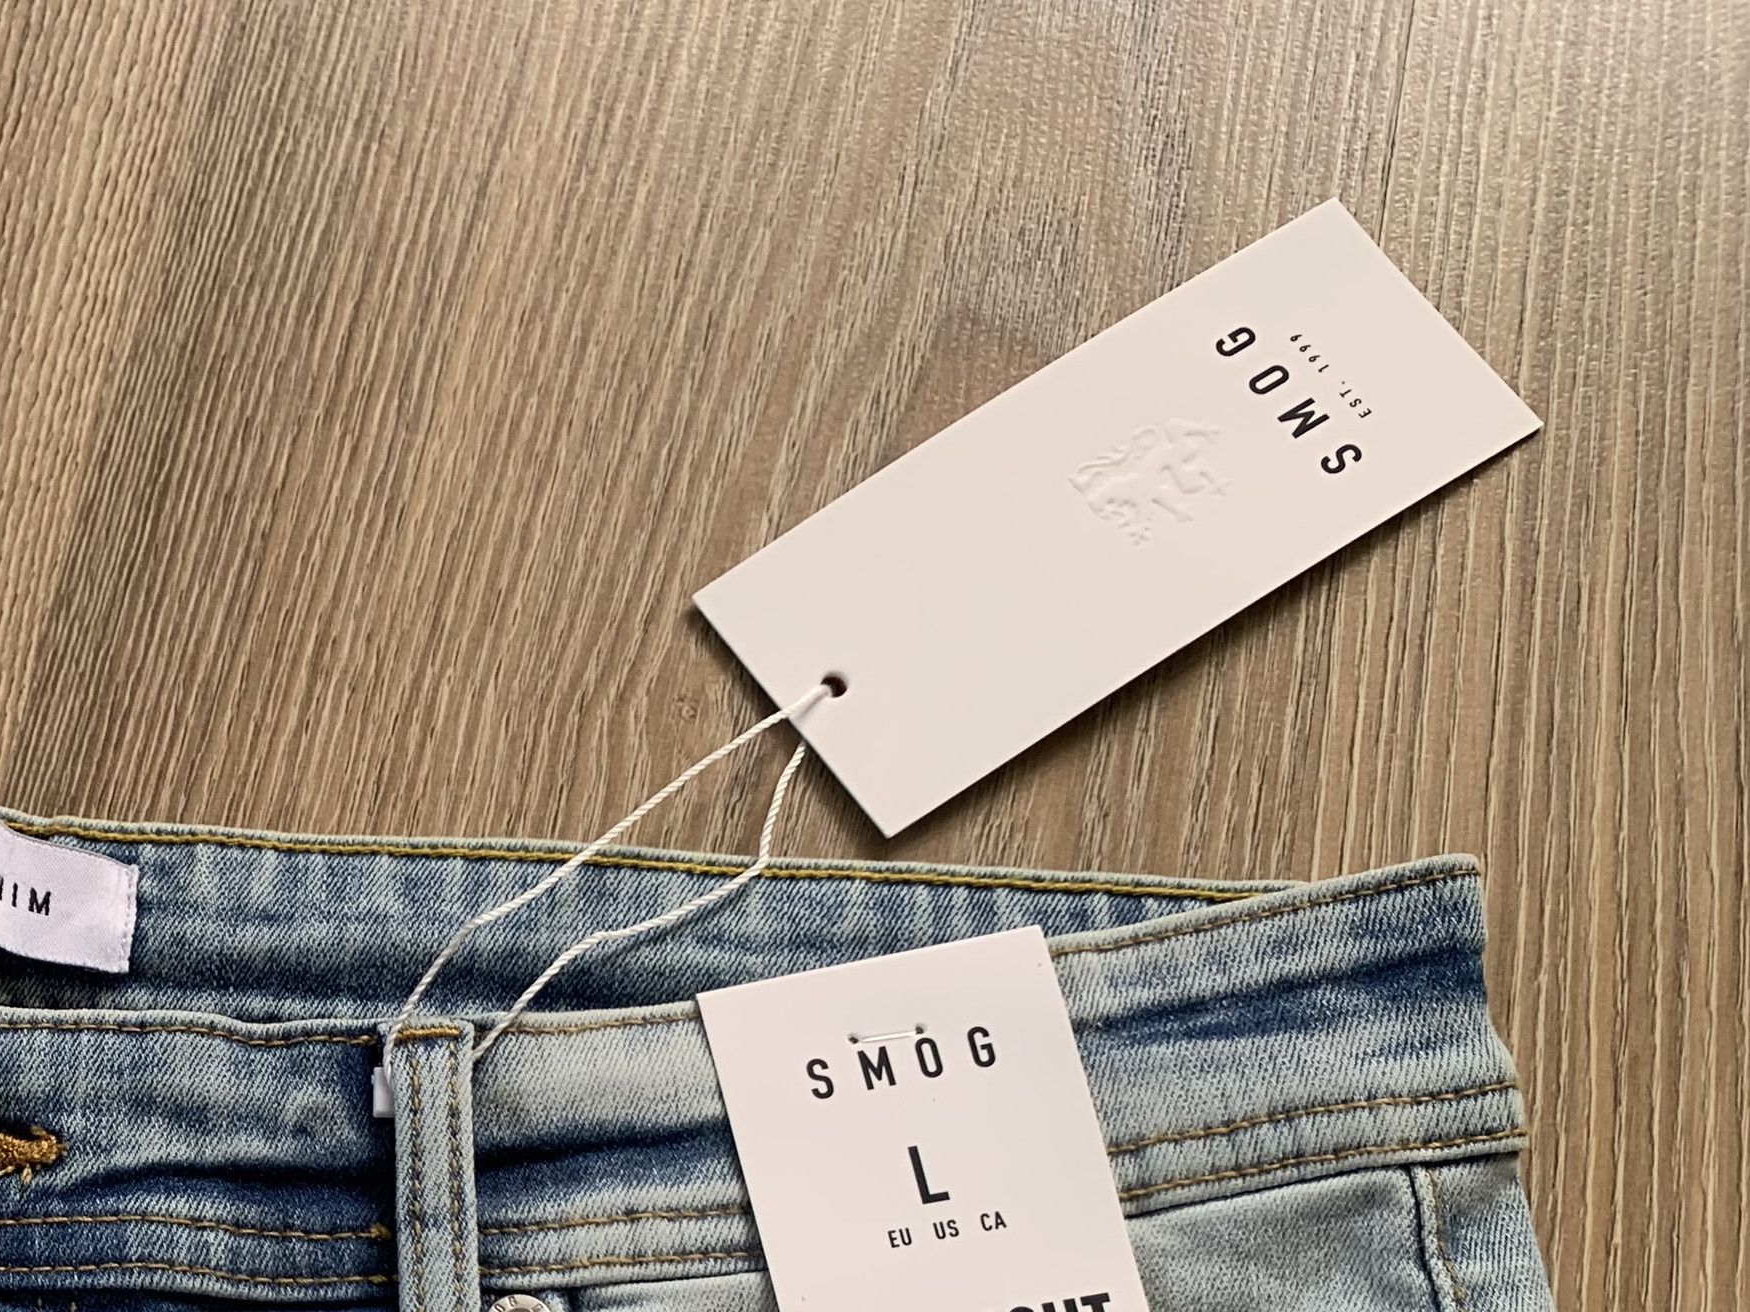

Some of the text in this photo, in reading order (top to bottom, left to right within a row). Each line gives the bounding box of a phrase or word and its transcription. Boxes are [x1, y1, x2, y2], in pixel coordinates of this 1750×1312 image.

[1215, 326, 1363, 475] SMOG
[1289, 334, 1372, 419] EST. 1999
[806, 1026, 996, 1100] SMOG
[907, 1145, 951, 1205] L
[887, 1211, 1007, 1249] EU US CA
